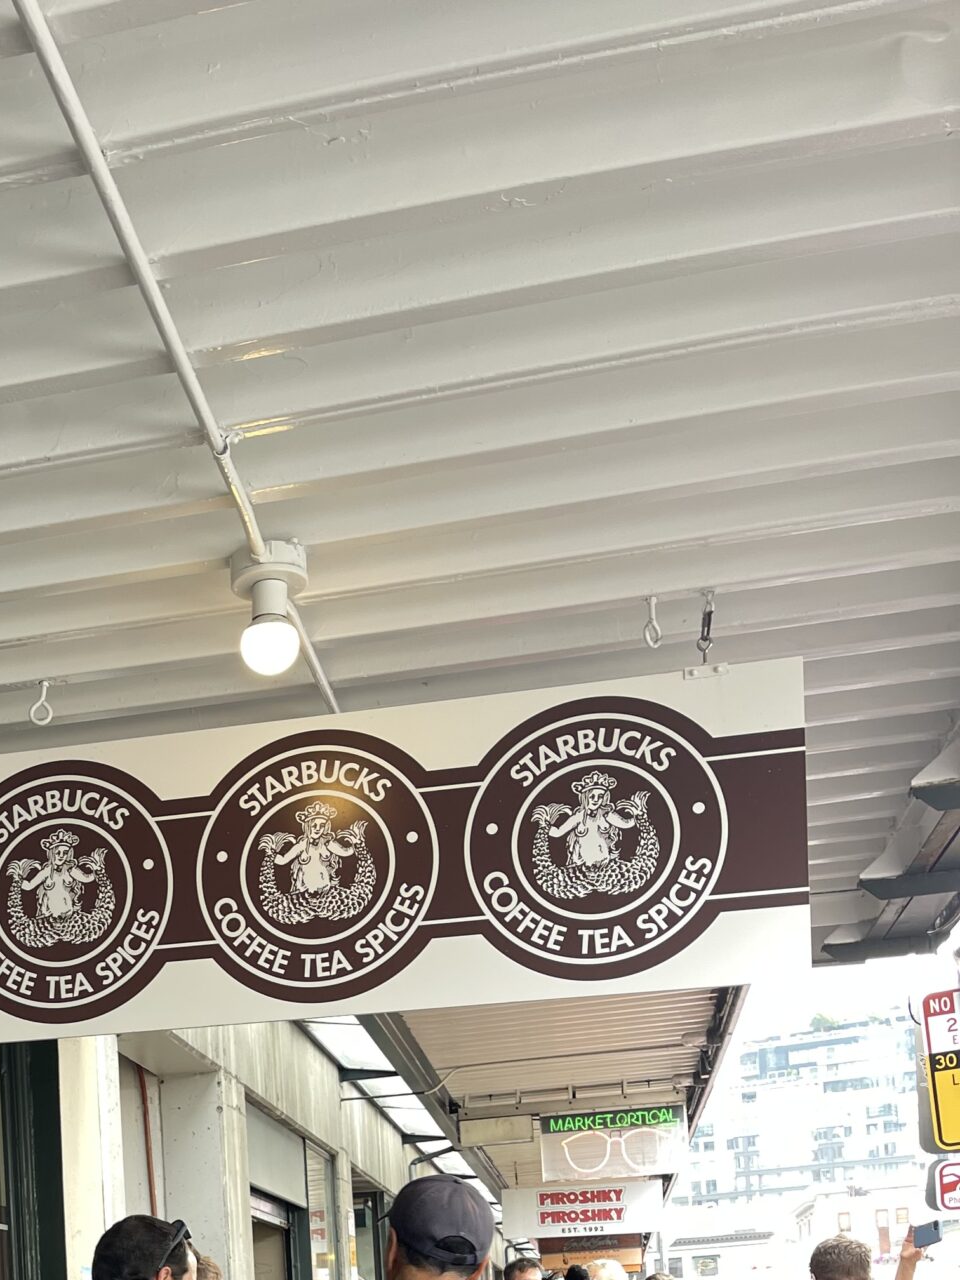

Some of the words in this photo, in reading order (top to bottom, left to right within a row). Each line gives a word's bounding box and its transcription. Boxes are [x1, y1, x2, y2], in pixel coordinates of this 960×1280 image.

[510, 728, 677, 787] STARBUCKS
[238, 759, 392, 818] STARBUCKS
[483, 870, 567, 951] COFFEE
[578, 928, 635, 955] TEA
[636, 855, 712, 939] SPICES
[214, 897, 292, 974] COFFEE
[301, 951, 351, 979] TEA
[357, 882, 424, 963] SPICES
[46, 972, 94, 1000] TEA
[96, 907, 160, 987] SPICES
[929, 997, 951, 1014] NO
[935, 1053, 957, 1069] 30
[550, 1115, 612, 1132] MARKET
[616, 1109, 675, 1126] OPTICAL
[539, 1189, 623, 1206] PIROSHKY
[540, 1208, 624, 1224] PIROSHKY
